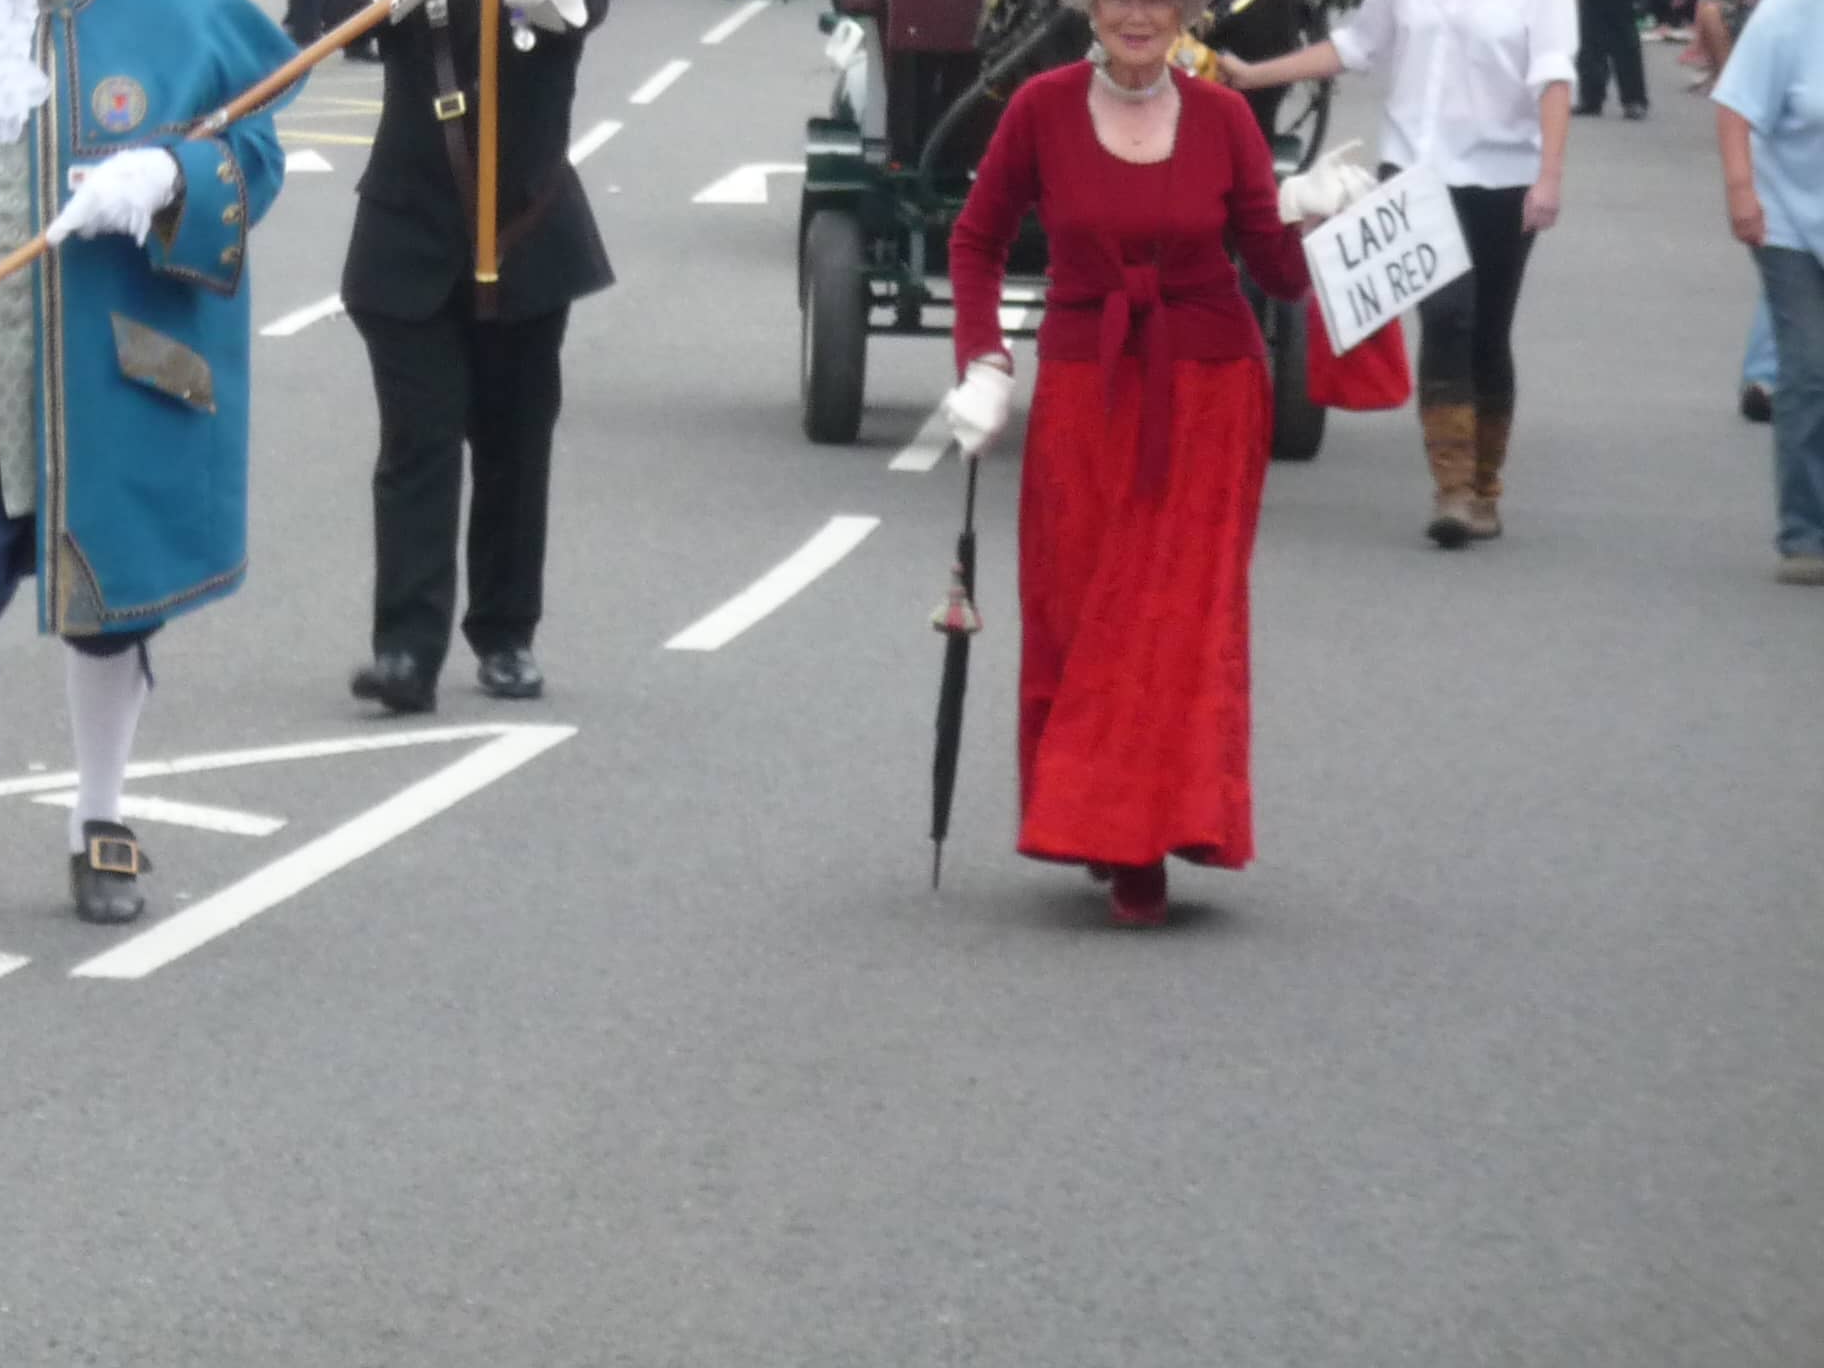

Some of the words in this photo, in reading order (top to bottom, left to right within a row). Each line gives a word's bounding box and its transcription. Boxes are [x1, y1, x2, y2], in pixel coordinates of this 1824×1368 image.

[1336, 191, 1411, 270] LADY
[1347, 275, 1382, 328] IN
[1386, 242, 1437, 303] RED
